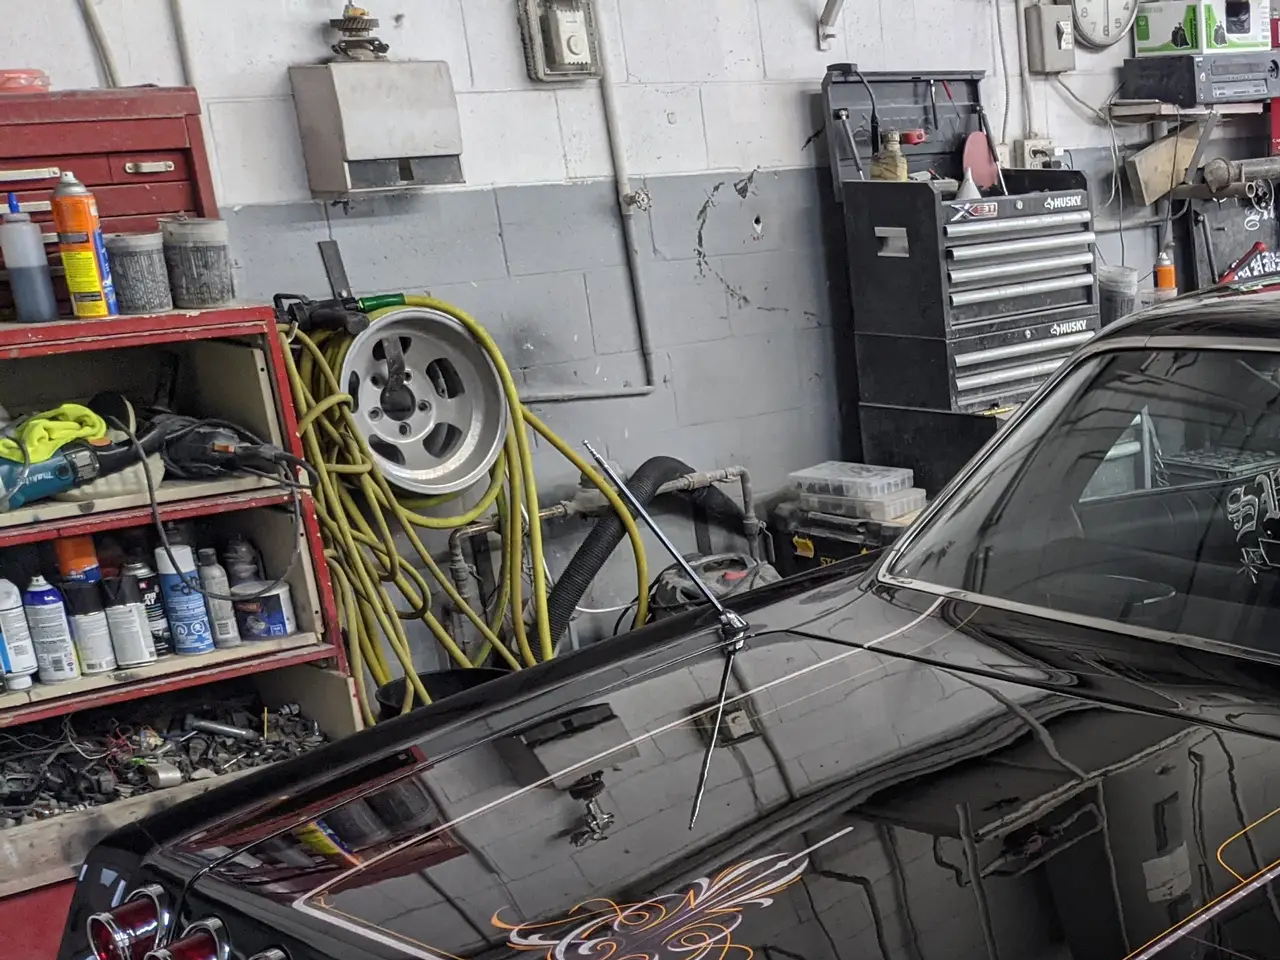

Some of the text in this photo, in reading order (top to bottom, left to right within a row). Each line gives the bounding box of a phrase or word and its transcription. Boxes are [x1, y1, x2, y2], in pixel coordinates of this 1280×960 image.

[1123, 1, 1130, 11] 4
[1081, 7, 1088, 18] 8
[1090, 22, 1097, 33] 7
[1114, 18, 1122, 29] 5
[1054, 195, 1082, 208] HUSKY
[1059, 320, 1087, 334] HUSKY
